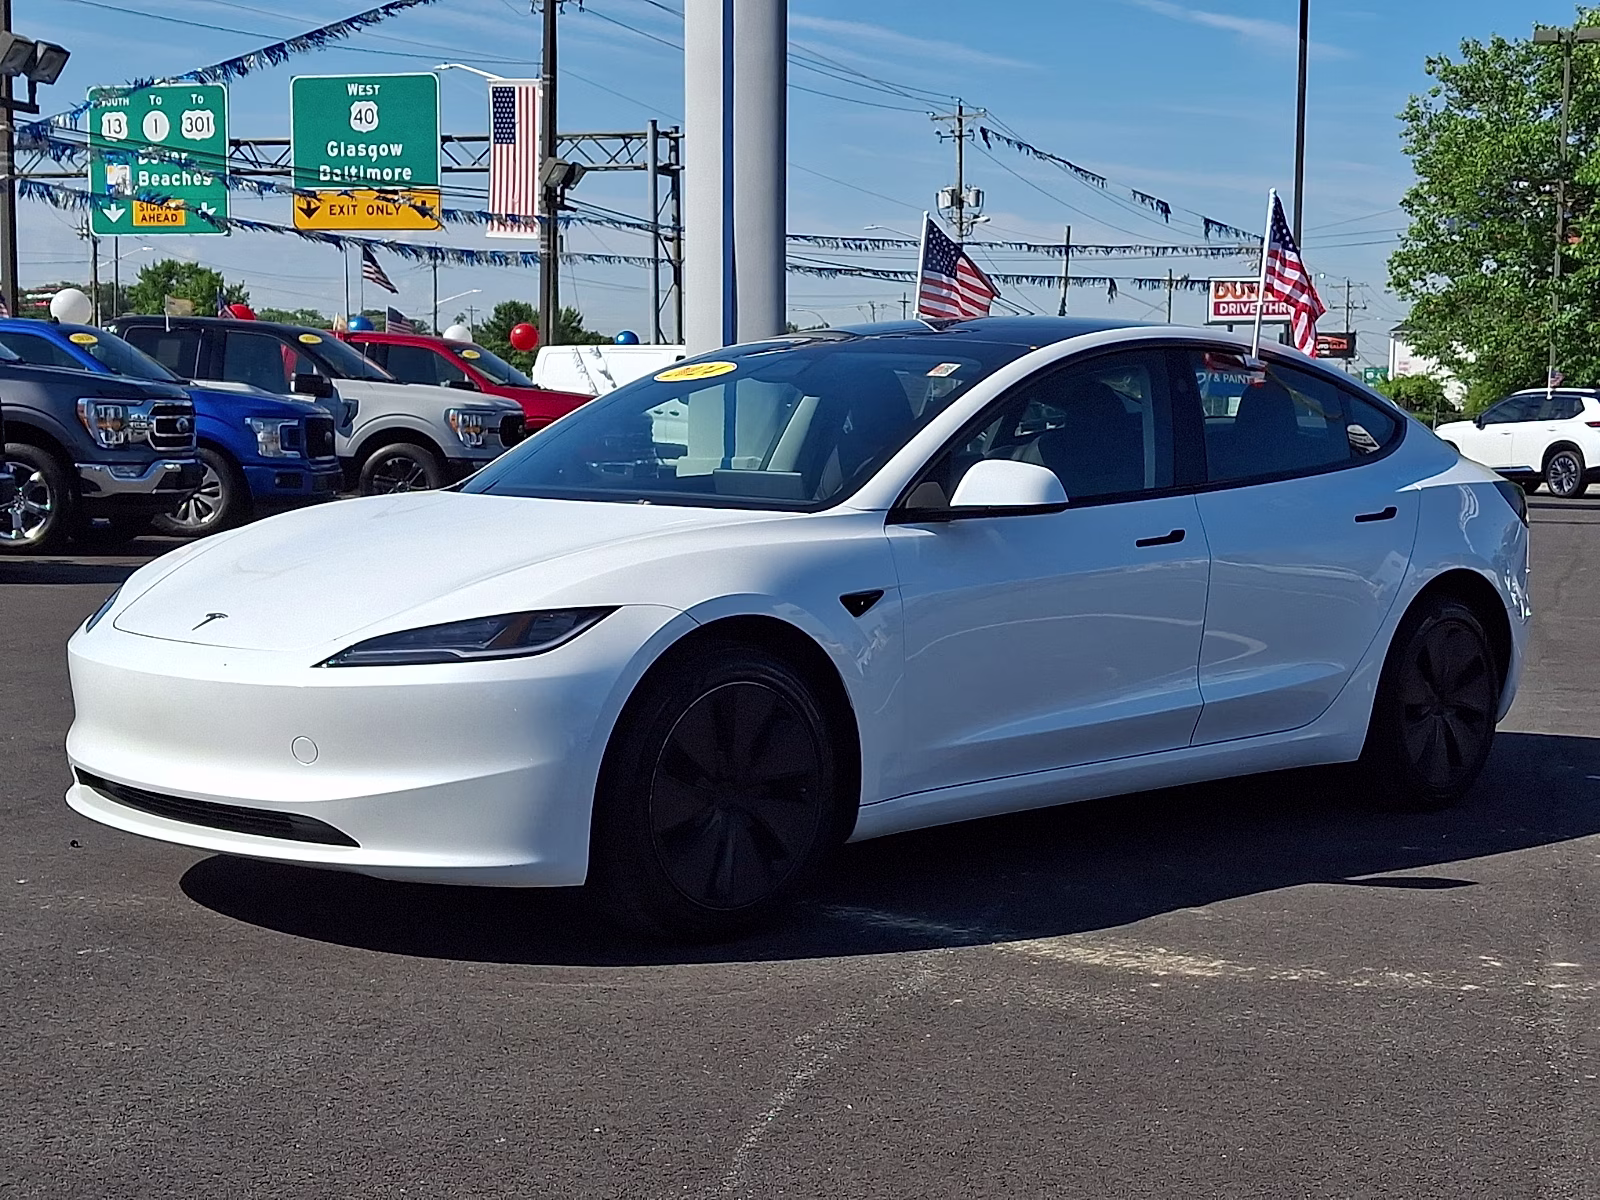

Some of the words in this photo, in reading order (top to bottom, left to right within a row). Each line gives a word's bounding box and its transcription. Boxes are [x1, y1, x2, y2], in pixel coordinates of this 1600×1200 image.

[347, 83, 380, 96] WEST
[101, 97, 130, 107] OUTH
[185, 116, 210, 133] 301
[353, 108, 375, 125] 40
[107, 118, 122, 135] 13
[327, 141, 403, 162] Glasgow
[138, 170, 213, 187] Beaches
[319, 165, 413, 181] Baltimore
[329, 204, 358, 216] EXIT
[366, 203, 402, 216] ONLY
[140, 213, 179, 223] AHEAD
[1220, 302, 1257, 314] DRIVE
